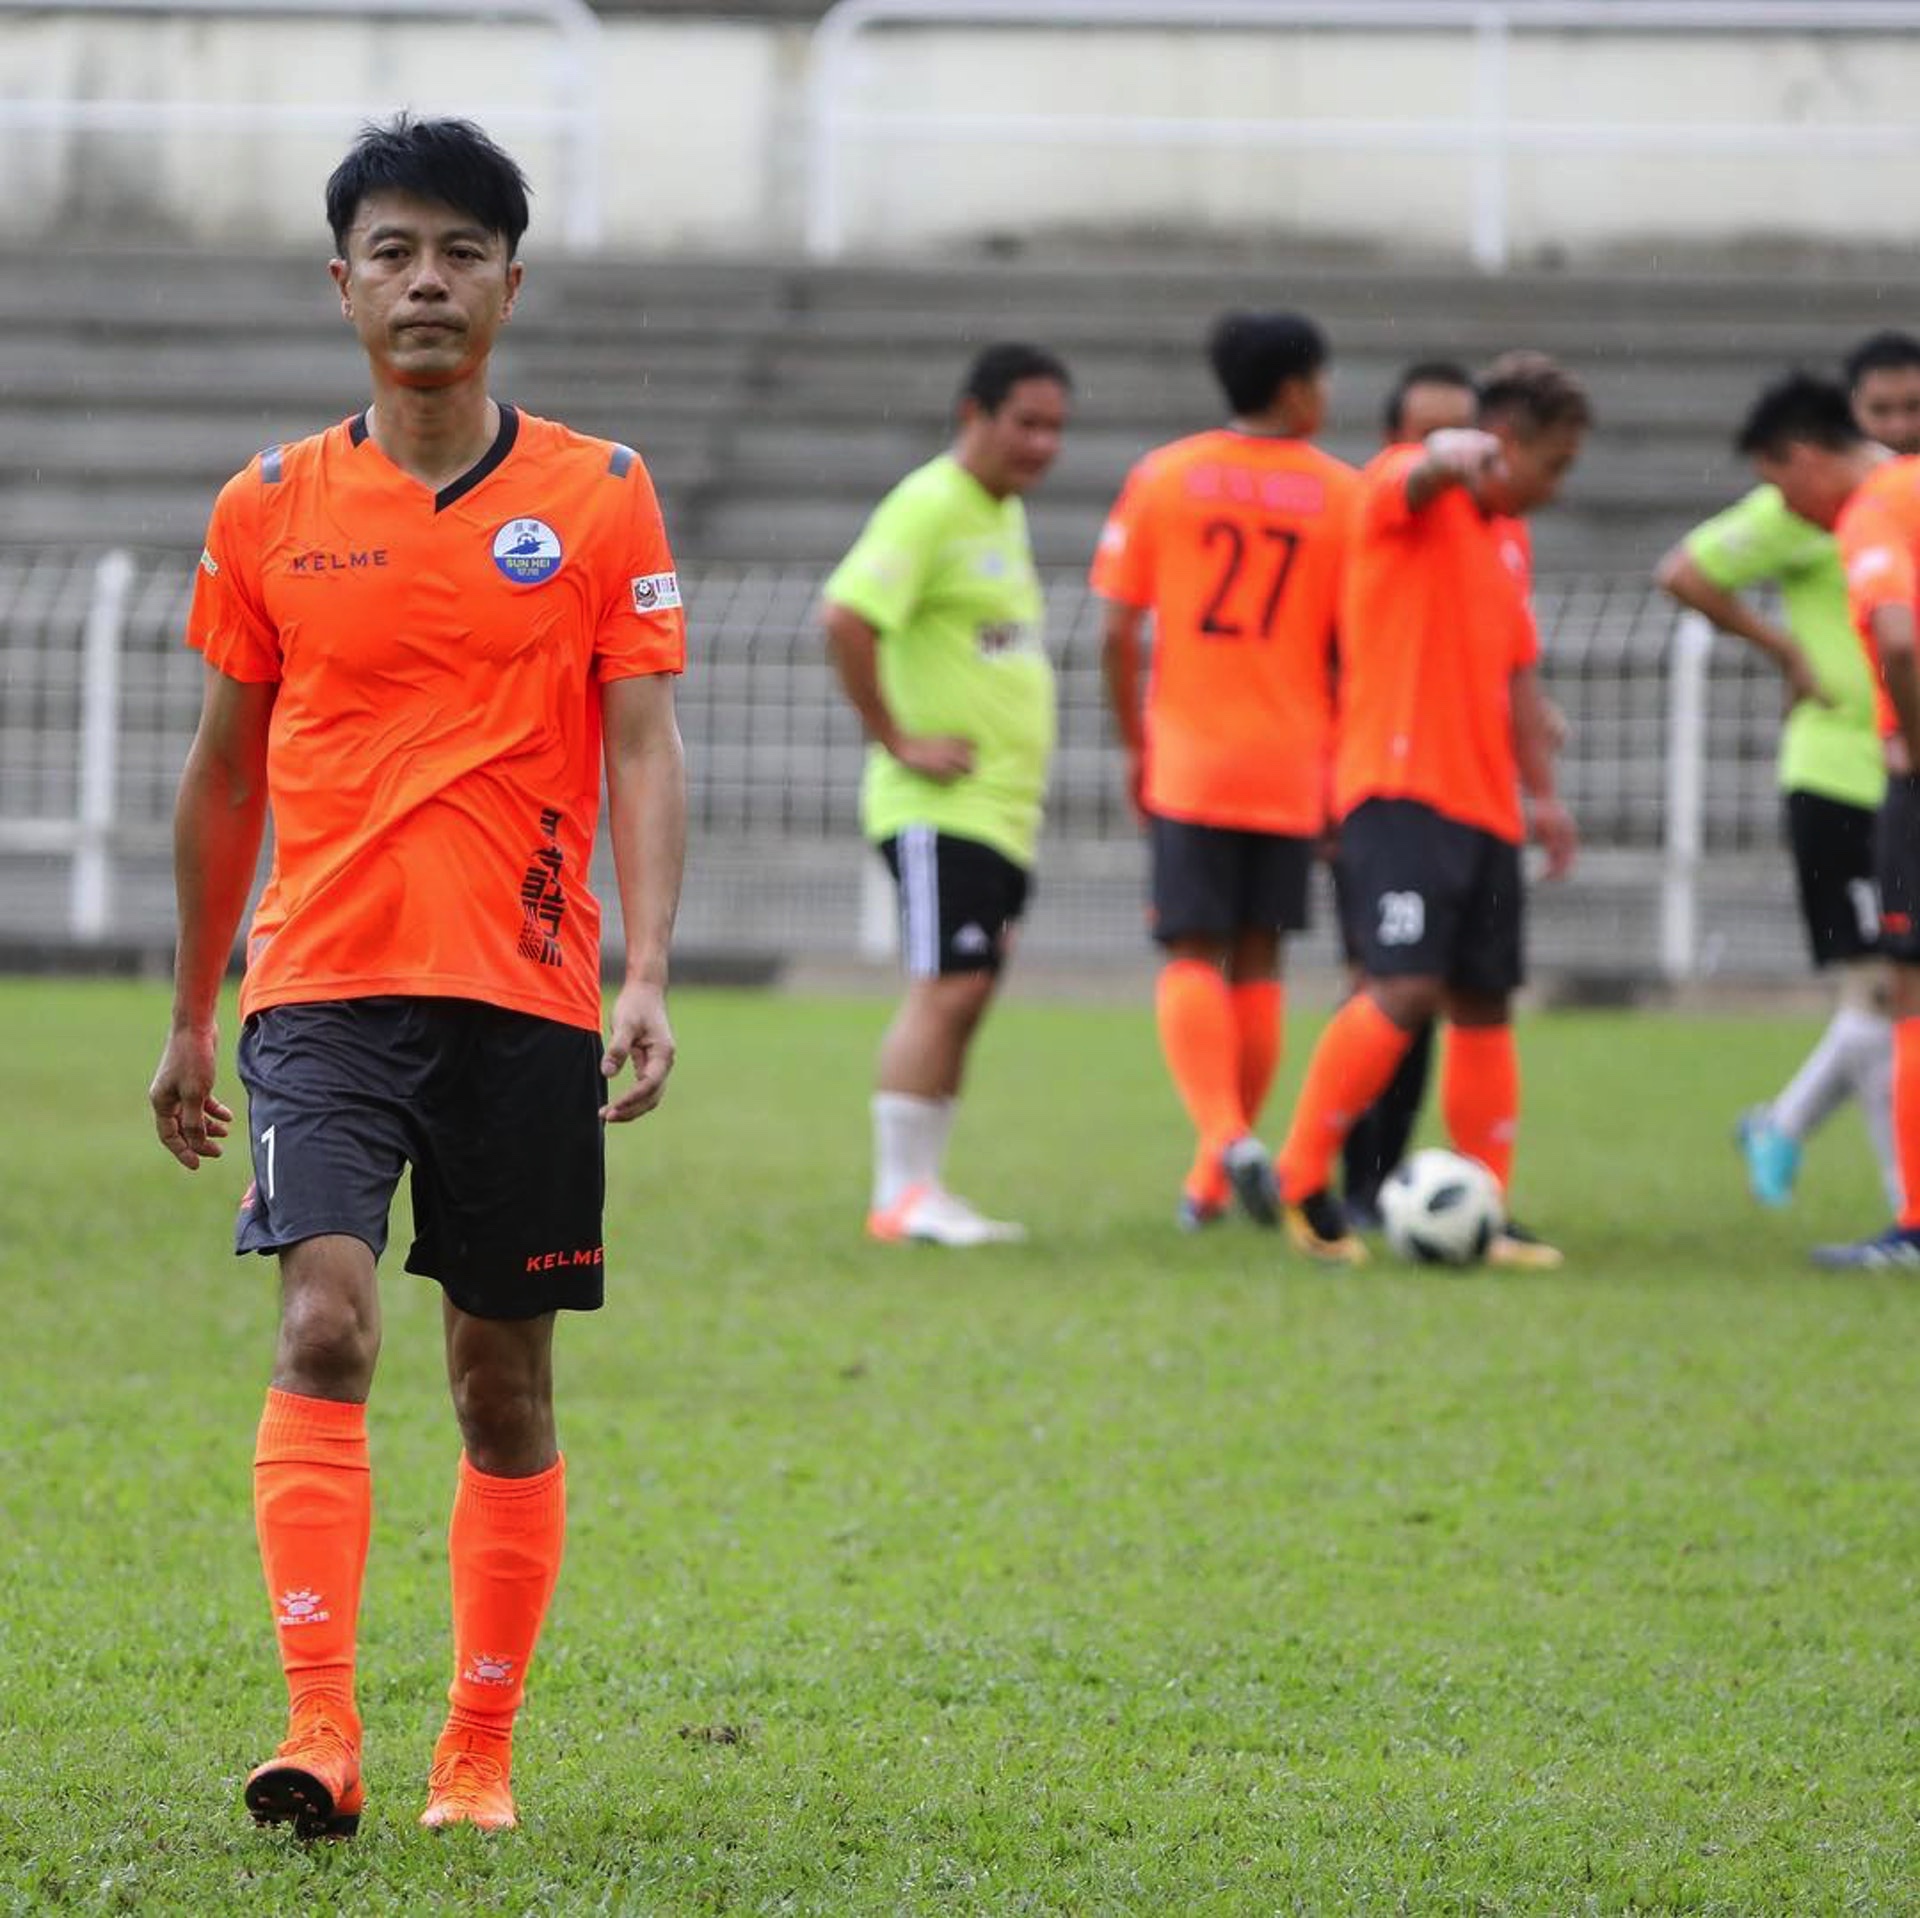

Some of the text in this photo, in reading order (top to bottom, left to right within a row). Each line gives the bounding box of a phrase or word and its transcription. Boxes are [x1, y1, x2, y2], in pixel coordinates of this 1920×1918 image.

[293, 549, 388, 571] KELME
[506, 557, 550, 568] SUN HEI
[1201, 518, 1303, 639] 27
[526, 1246, 604, 1272] KELME
